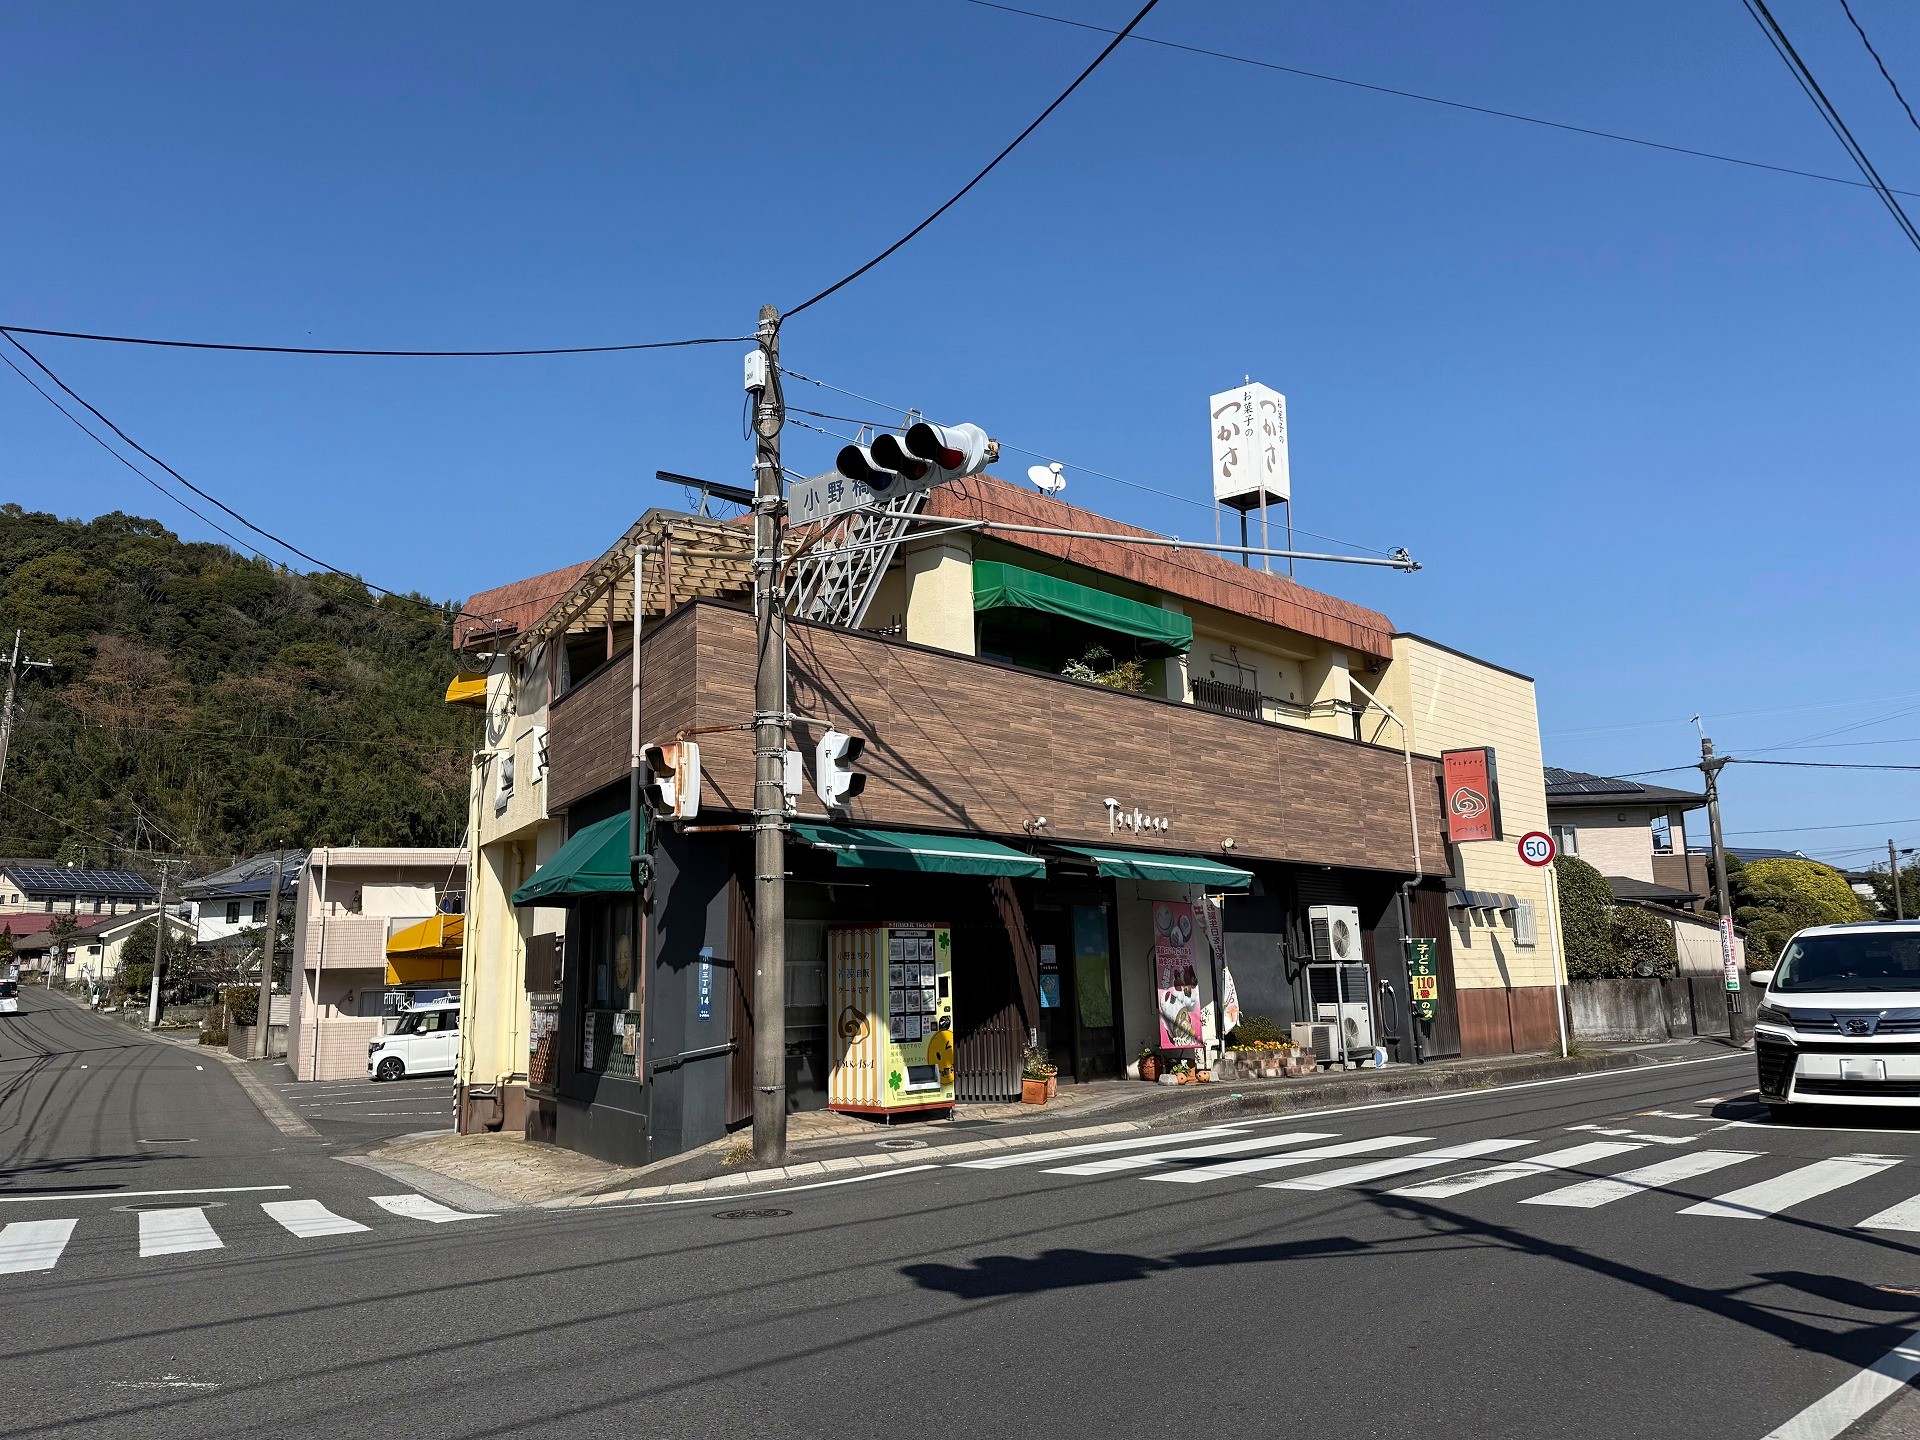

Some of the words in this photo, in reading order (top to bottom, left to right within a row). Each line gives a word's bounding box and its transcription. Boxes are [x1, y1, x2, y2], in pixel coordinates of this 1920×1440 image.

[1243, 391, 1254, 437] お菓子の
[1259, 400, 1276, 474] つかさ
[1212, 401, 1242, 478] つかさ
[1103, 797, 1169, 836] Tsukasa
[1526, 840, 1547, 857] 50
